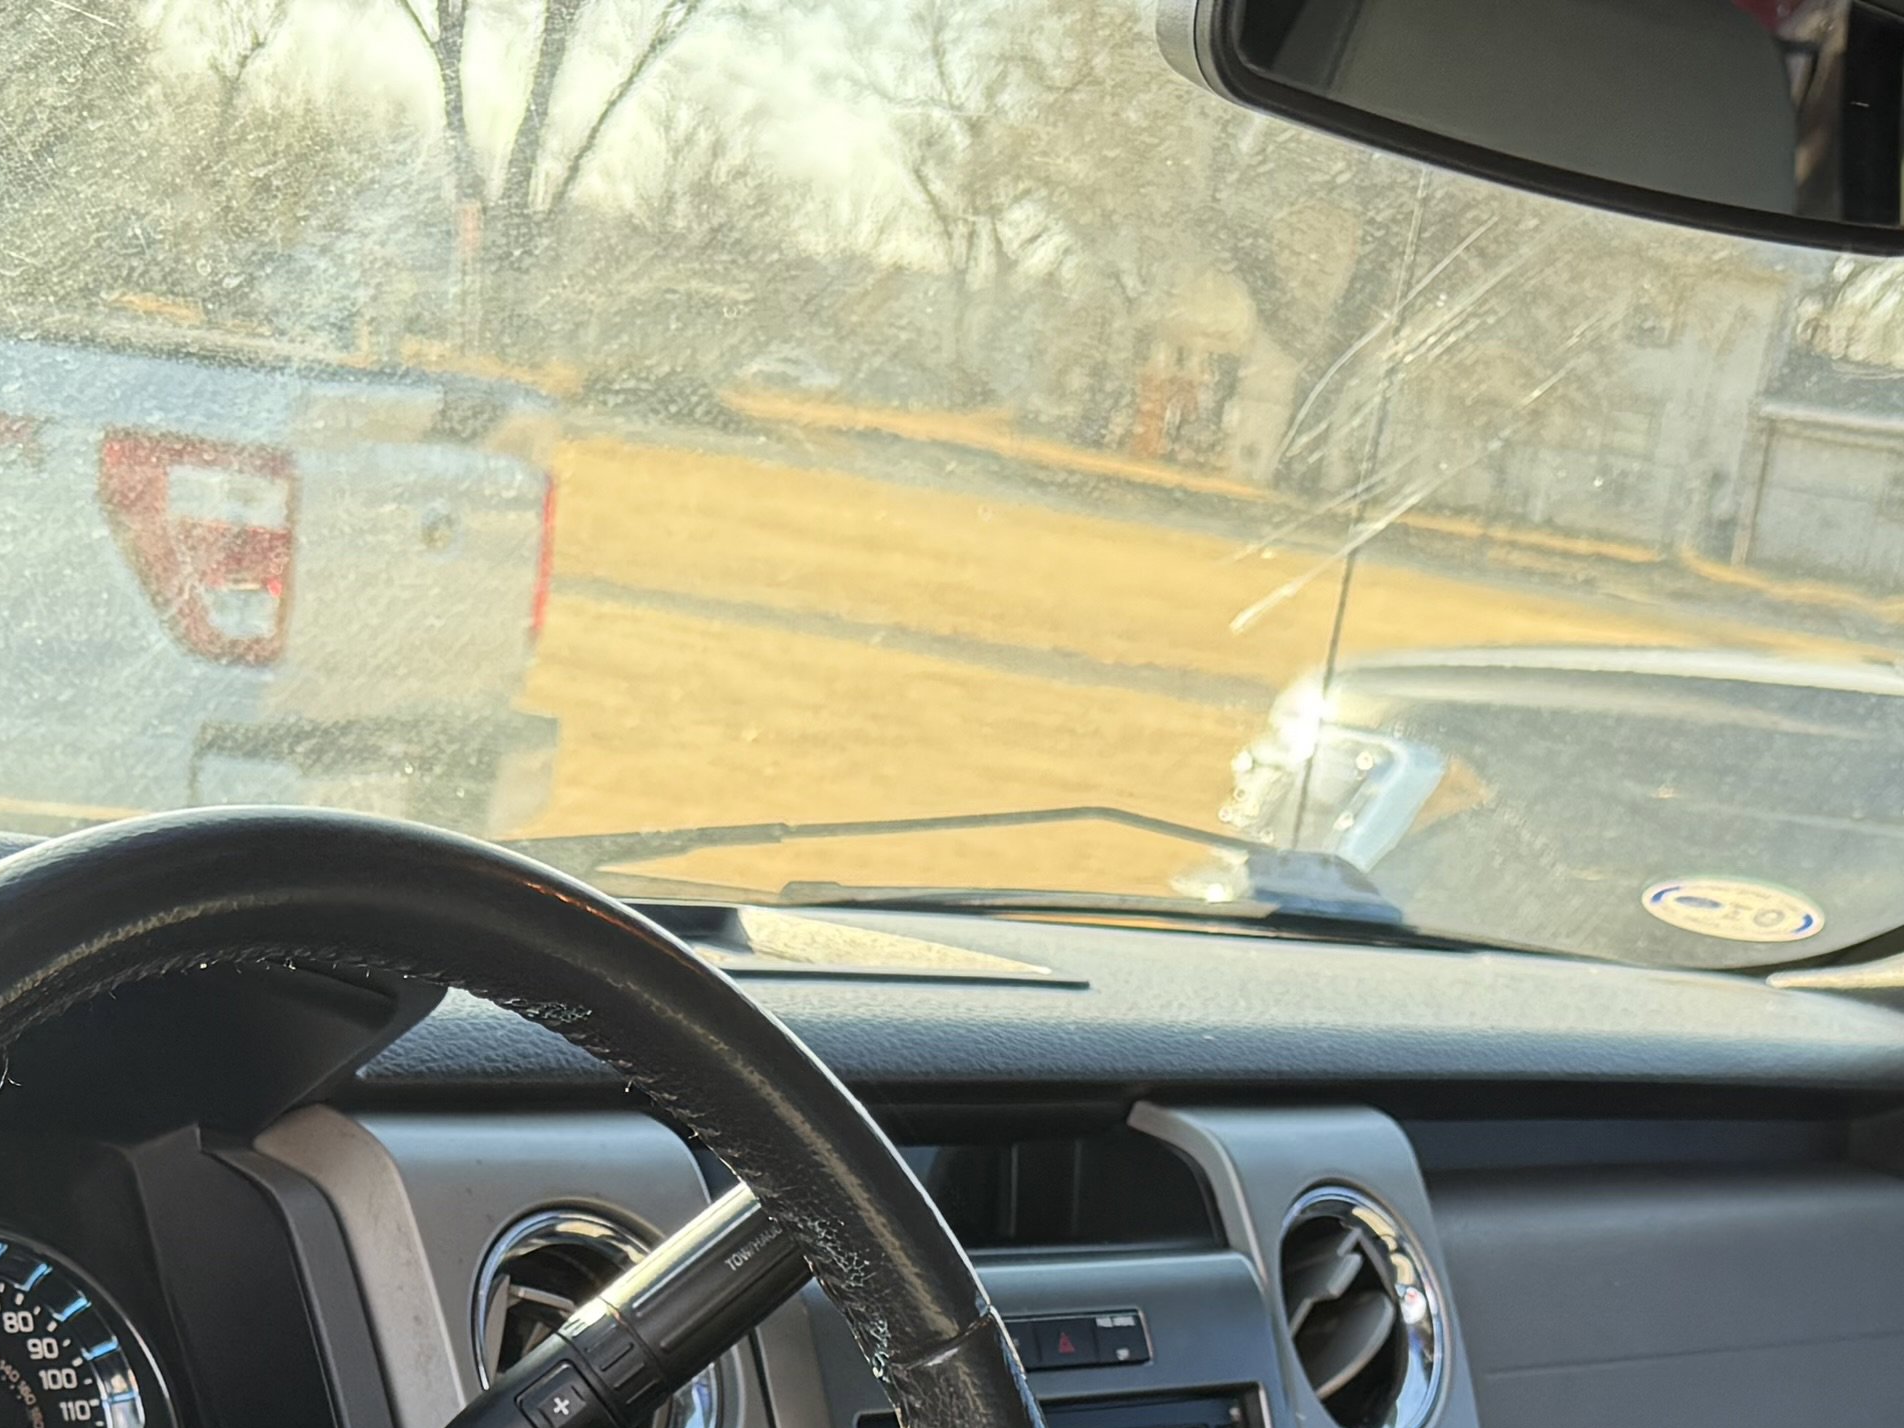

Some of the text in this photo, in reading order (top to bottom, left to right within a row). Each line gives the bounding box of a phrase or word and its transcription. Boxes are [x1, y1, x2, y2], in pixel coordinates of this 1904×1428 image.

[2, 1311, 34, 1334] 80
[27, 1337, 59, 1360] 90
[38, 1368, 78, 1390] 100
[59, 1400, 91, 1422] 110
